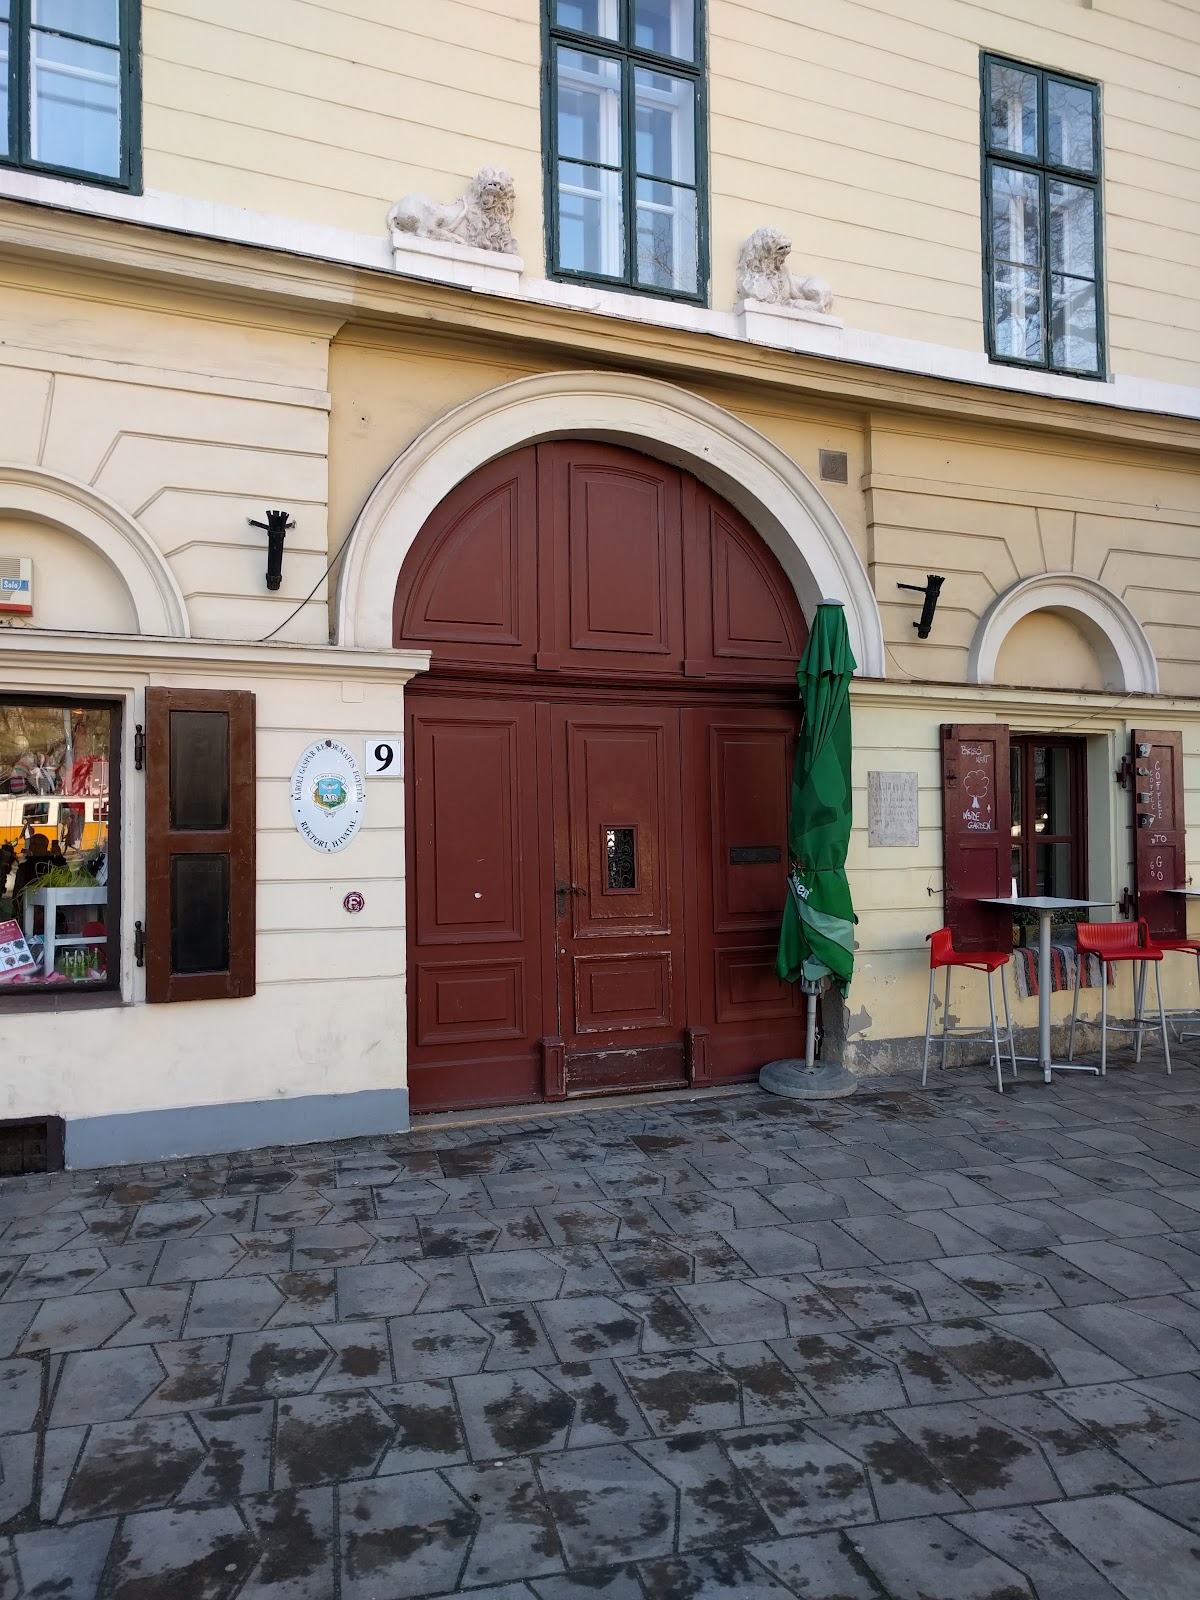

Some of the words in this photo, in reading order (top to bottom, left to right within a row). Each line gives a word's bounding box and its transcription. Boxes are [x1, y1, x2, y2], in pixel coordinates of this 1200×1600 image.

[3, 580, 18, 589] Solo
[374, 744, 393, 772] 9
[294, 775, 304, 801] KÁROLI
[299, 751, 317, 775] GÁSPÁR
[352, 770, 363, 803] EGYETEM
[300, 820, 328, 848] REKTORI
[331, 819, 357, 848] HIVATAL
[967, 818, 992, 830] GARDEN
[1154, 834, 1167, 843] TO
[1150, 861, 1155, 877] GO
[1156, 855, 1164, 881] GO
